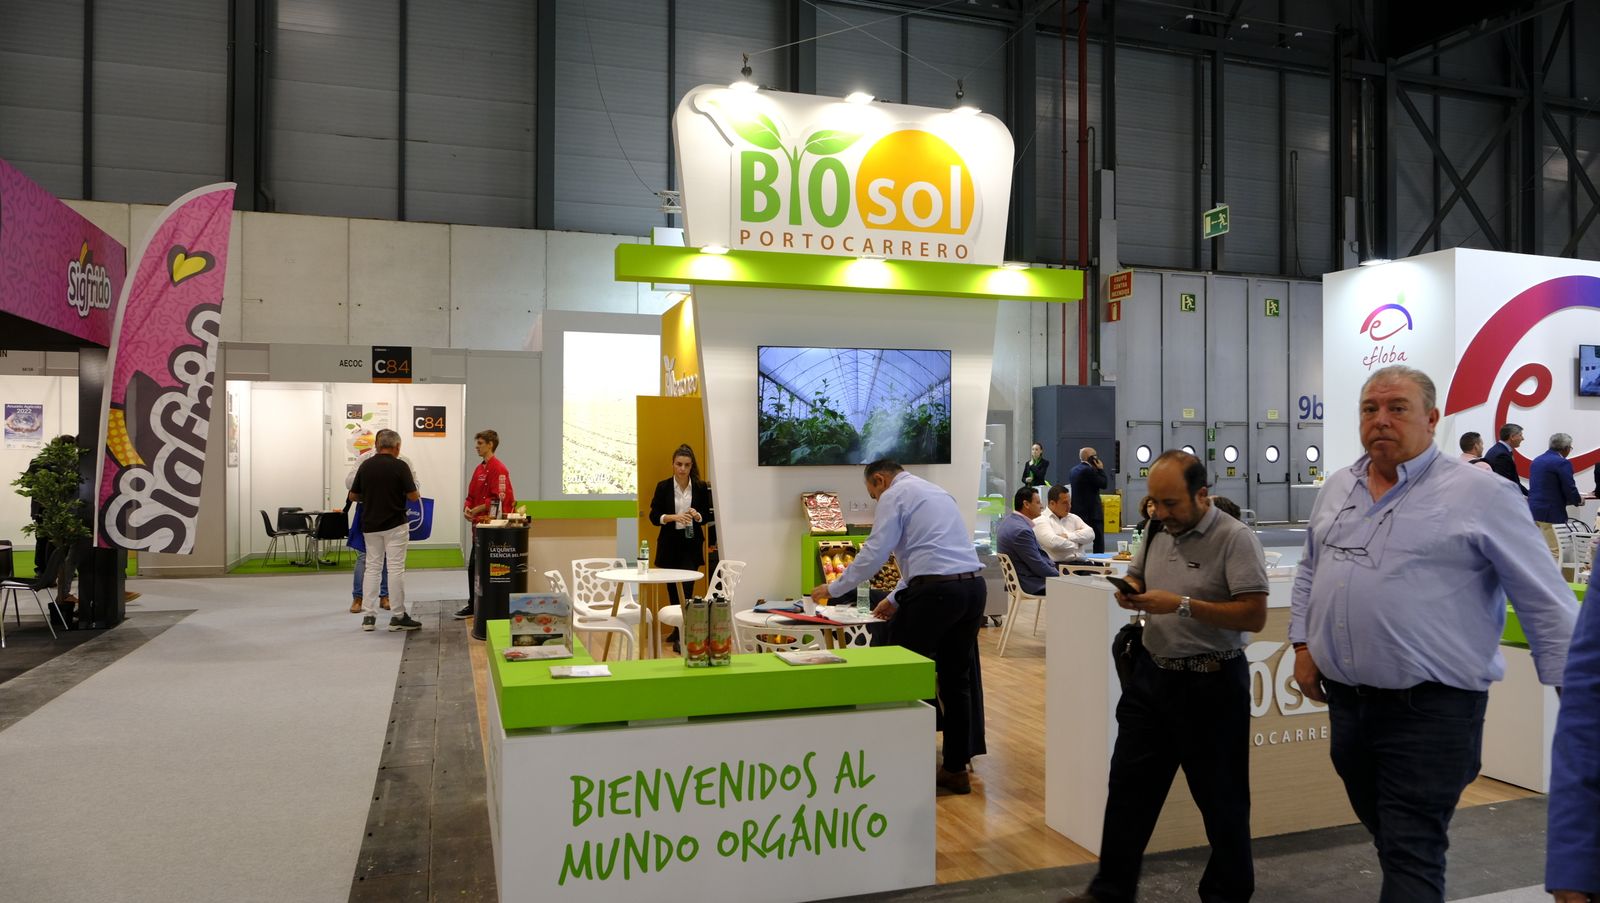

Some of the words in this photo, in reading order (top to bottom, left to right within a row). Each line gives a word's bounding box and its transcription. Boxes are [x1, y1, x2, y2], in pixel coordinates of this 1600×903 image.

[739, 228, 968, 260] PORTOCARRERO
[68, 262, 111, 314] Sigfrido
[339, 359, 363, 368] AECOC
[374, 359, 410, 374] C84
[1362, 345, 1407, 369] efloba
[347, 410, 362, 418] C84
[1298, 395, 1323, 420] 9b
[415, 416, 444, 429] C84
[570, 751, 817, 828] BIENVENIDOS
[834, 749, 876, 795] AL
[558, 829, 700, 886] MUNDO
[717, 803, 888, 862] ORGÁNICO
